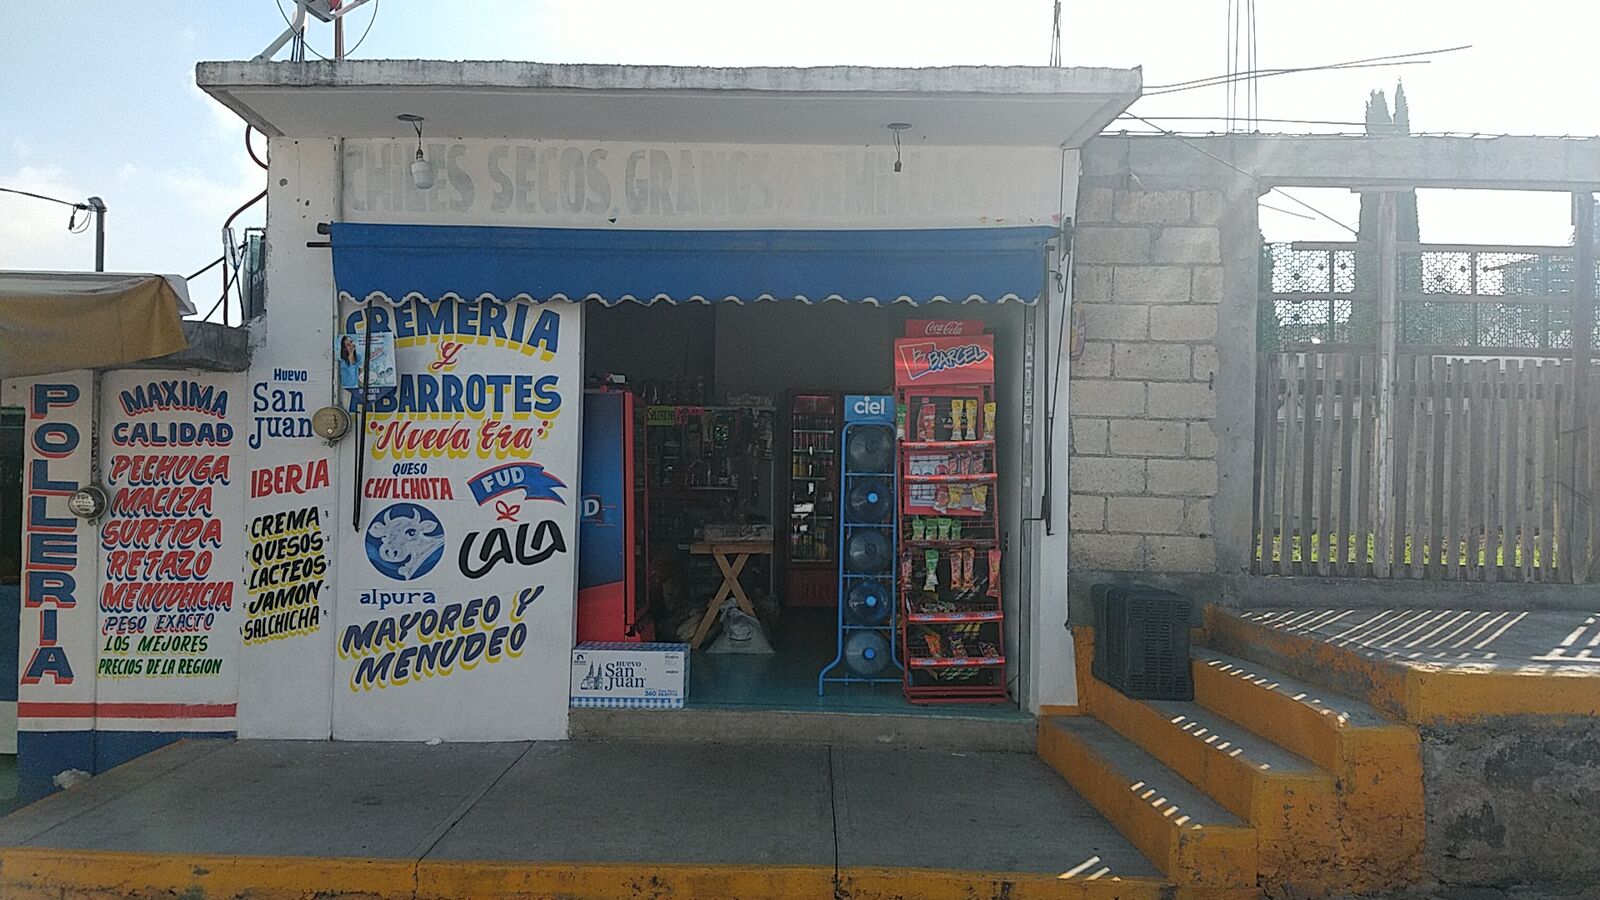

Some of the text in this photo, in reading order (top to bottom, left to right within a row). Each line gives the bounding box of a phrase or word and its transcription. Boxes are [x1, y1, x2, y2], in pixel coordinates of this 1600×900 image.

[346, 297, 560, 361] CREMERIA
[927, 343, 990, 373] BARCEL
[274, 368, 307, 381] Huevo
[119, 380, 228, 419] MAXIMA
[254, 382, 305, 413] San
[854, 396, 885, 415] ciel
[111, 422, 234, 447] CALIDAD
[249, 416, 313, 448] Juan
[108, 454, 231, 486] PECHUGA
[250, 458, 330, 498] IBERIA
[392, 462, 427, 476] QUESO
[480, 467, 526, 494] FUD
[110, 486, 214, 518] MACIZA
[364, 477, 454, 500] CHILCHOTA
[21, 384, 80, 685] POLLERIA
[101, 518, 223, 550] SURTIDA
[250, 506, 320, 541] CREMA
[250, 531, 324, 566] QUESOS
[458, 520, 567, 579] LALA
[106, 550, 213, 582] RETAZO
[248, 555, 327, 593] LACTEOS
[99, 581, 234, 614] MENUDENCIA
[248, 580, 323, 616] JAMON
[359, 588, 436, 610] alpura
[102, 611, 216, 636] PESO EXACTO
[243, 604, 320, 645] SALCHICHA
[338, 585, 545, 660] MAYOREO Y
[103, 635, 209, 654] LOS MEJORES
[350, 622, 527, 692] MENUDEO
[98, 657, 223, 679] PRECIOS DE LA REGION
[604, 677, 645, 691] Juan
[605, 663, 634, 677] San
